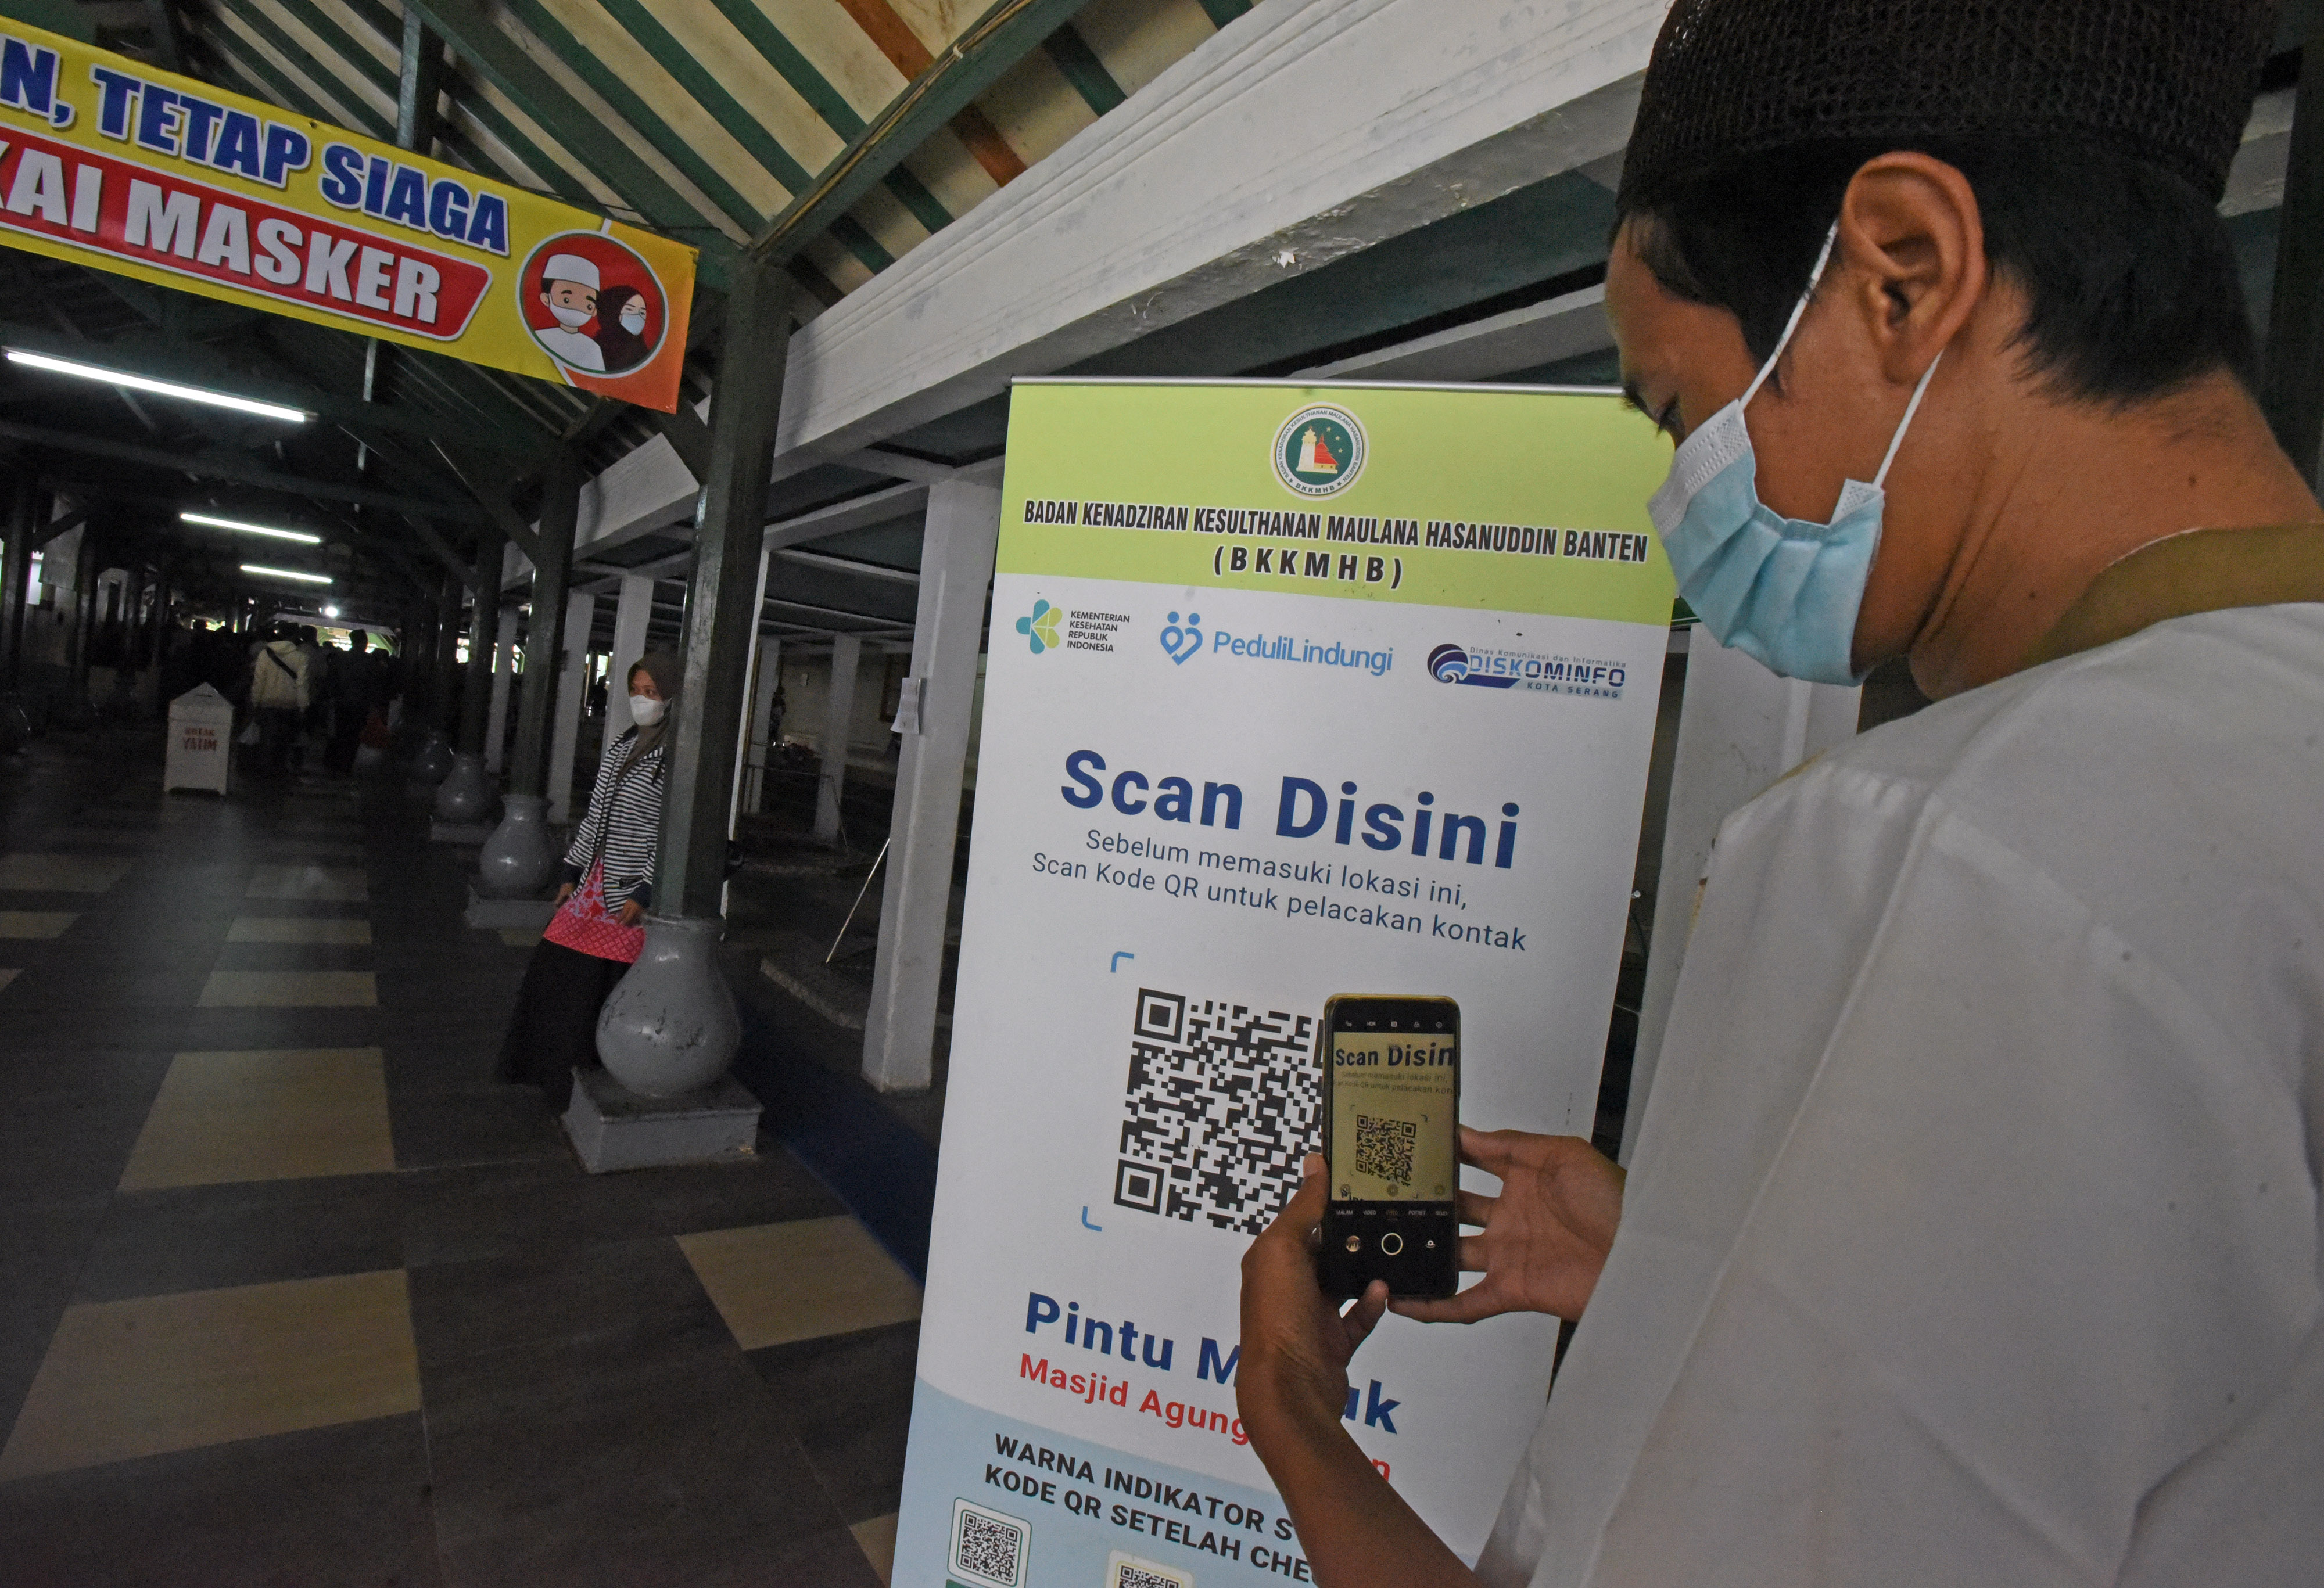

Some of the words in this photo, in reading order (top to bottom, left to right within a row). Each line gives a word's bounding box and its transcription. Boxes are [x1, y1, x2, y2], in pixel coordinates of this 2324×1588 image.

[93, 66, 308, 186] TETAP
[320, 143, 509, 253] SIAGA
[0, 140, 102, 233] AI
[124, 179, 440, 324] MASKER
[1328, 411, 1351, 427] MAULANA
[1295, 483, 1335, 493] BKKMHB
[1024, 500, 1077, 524] BADAN
[1082, 502, 1188, 531] KENADZIRAN
[1194, 508, 1319, 538] KESULTHANAN
[1326, 515, 1418, 546] MAULANA
[1425, 521, 1557, 555] HASANUDDIN
[1563, 530, 1648, 562] BANTEN
[1068, 631, 1108, 641] REPUBLIK
[1069, 620, 1118, 632] KESEHATAN
[1071, 610, 1130, 623] KEMENTERIAN
[1067, 641, 1114, 652] INDONESIA
[1213, 631, 1393, 676] PeduliLindungi
[1470, 646, 1494, 655] Dinas
[1498, 649, 1549, 660] Komunikasi
[1573, 656, 1626, 668] Informatika
[1469, 655, 1625, 687] DISKOMINFO
[1527, 682, 1558, 692] KOTA
[1568, 686, 1618, 698] SERANG
[1061, 749, 1242, 830] Scan
[1276, 775, 1519, 869] Disini
[1086, 829, 1188, 864] Sebelum
[1199, 850, 1332, 884] memasuki
[1341, 865, 1419, 899] lokasi
[1429, 879, 1467, 910] ini,
[1032, 852, 1086, 879] Scan
[1096, 863, 1156, 890] Kode
[1164, 874, 1199, 898] QR
[1208, 885, 1278, 910] untuk
[1287, 896, 1422, 933] pelacakan
[1432, 914, 1527, 951] kontak
[1336, 1048, 1378, 1066] Scan
[1025, 1291, 1174, 1371] Pintu
[1020, 1353, 1129, 1407] Masjid
[1139, 1390, 1249, 1445] Agung
[995, 1433, 1095, 1483] WARNA
[1104, 1468, 1264, 1533] INDIKATOR
[985, 1463, 1056, 1503] KODE
[1064, 1490, 1102, 1519] QR
[1111, 1504, 1241, 1561] SETELAH
